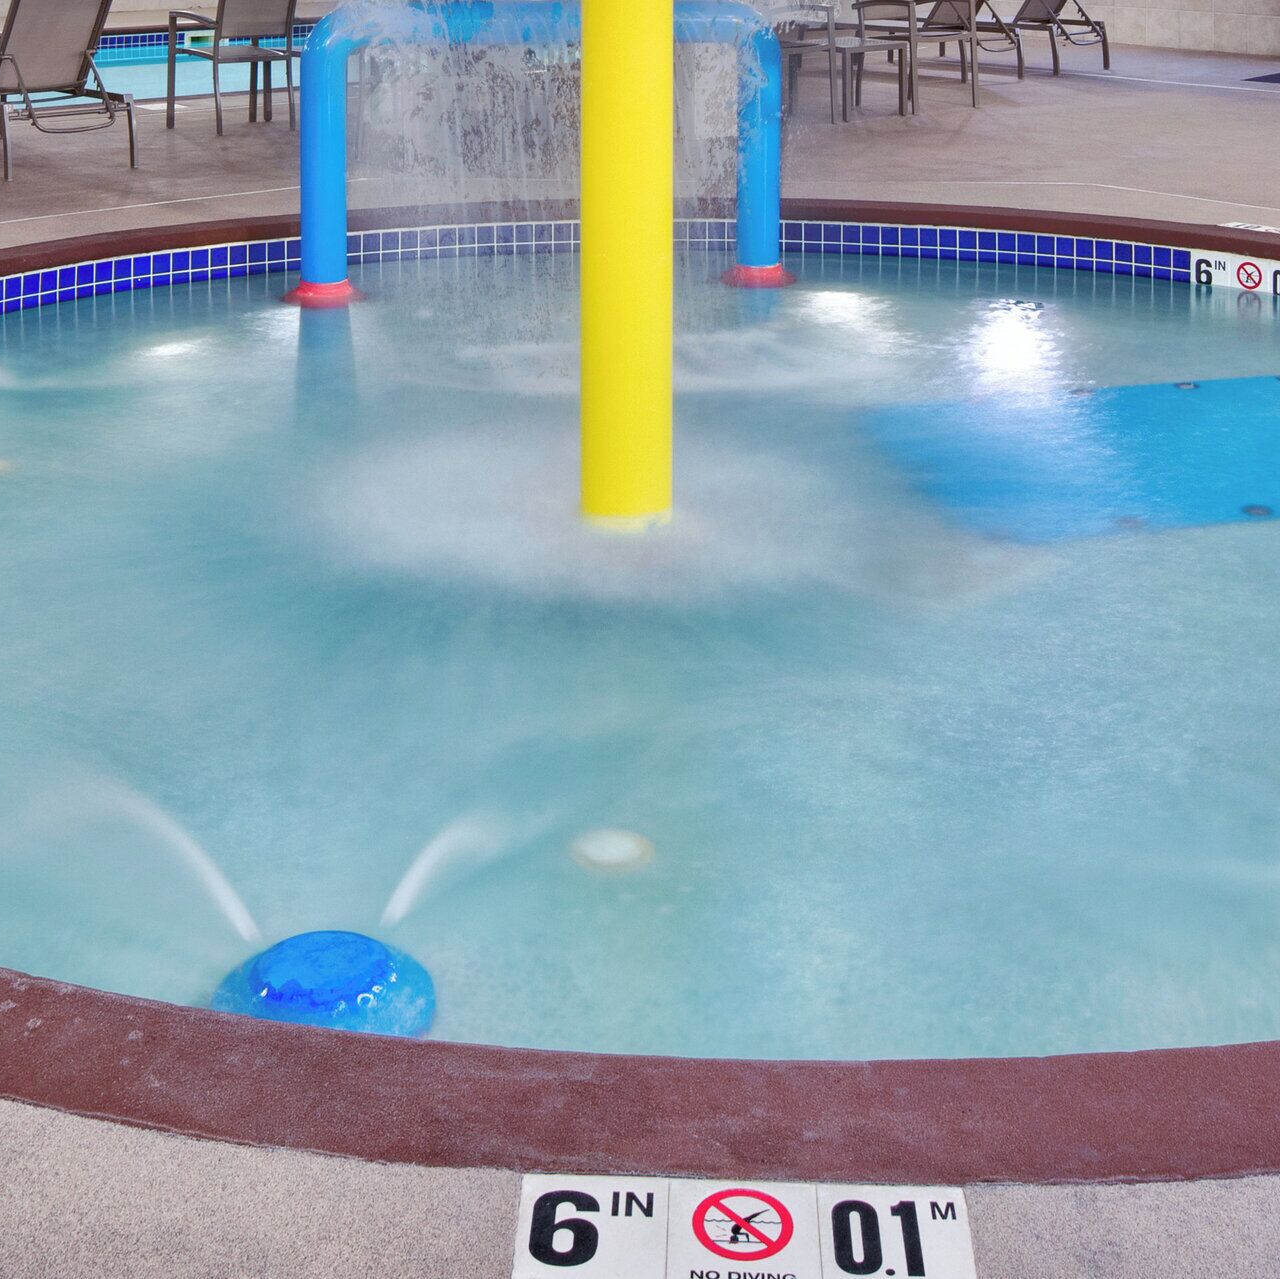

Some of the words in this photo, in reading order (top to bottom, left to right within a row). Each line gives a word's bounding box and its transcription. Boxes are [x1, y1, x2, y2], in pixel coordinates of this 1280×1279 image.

[1195, 259, 1212, 284] 6
[1214, 260, 1226, 271] IN
[528, 1190, 600, 1267] 6
[610, 1191, 654, 1217] IN
[831, 1199, 926, 1277] 0.1
[931, 1201, 957, 1220] M
[689, 1270, 721, 1279] NO
